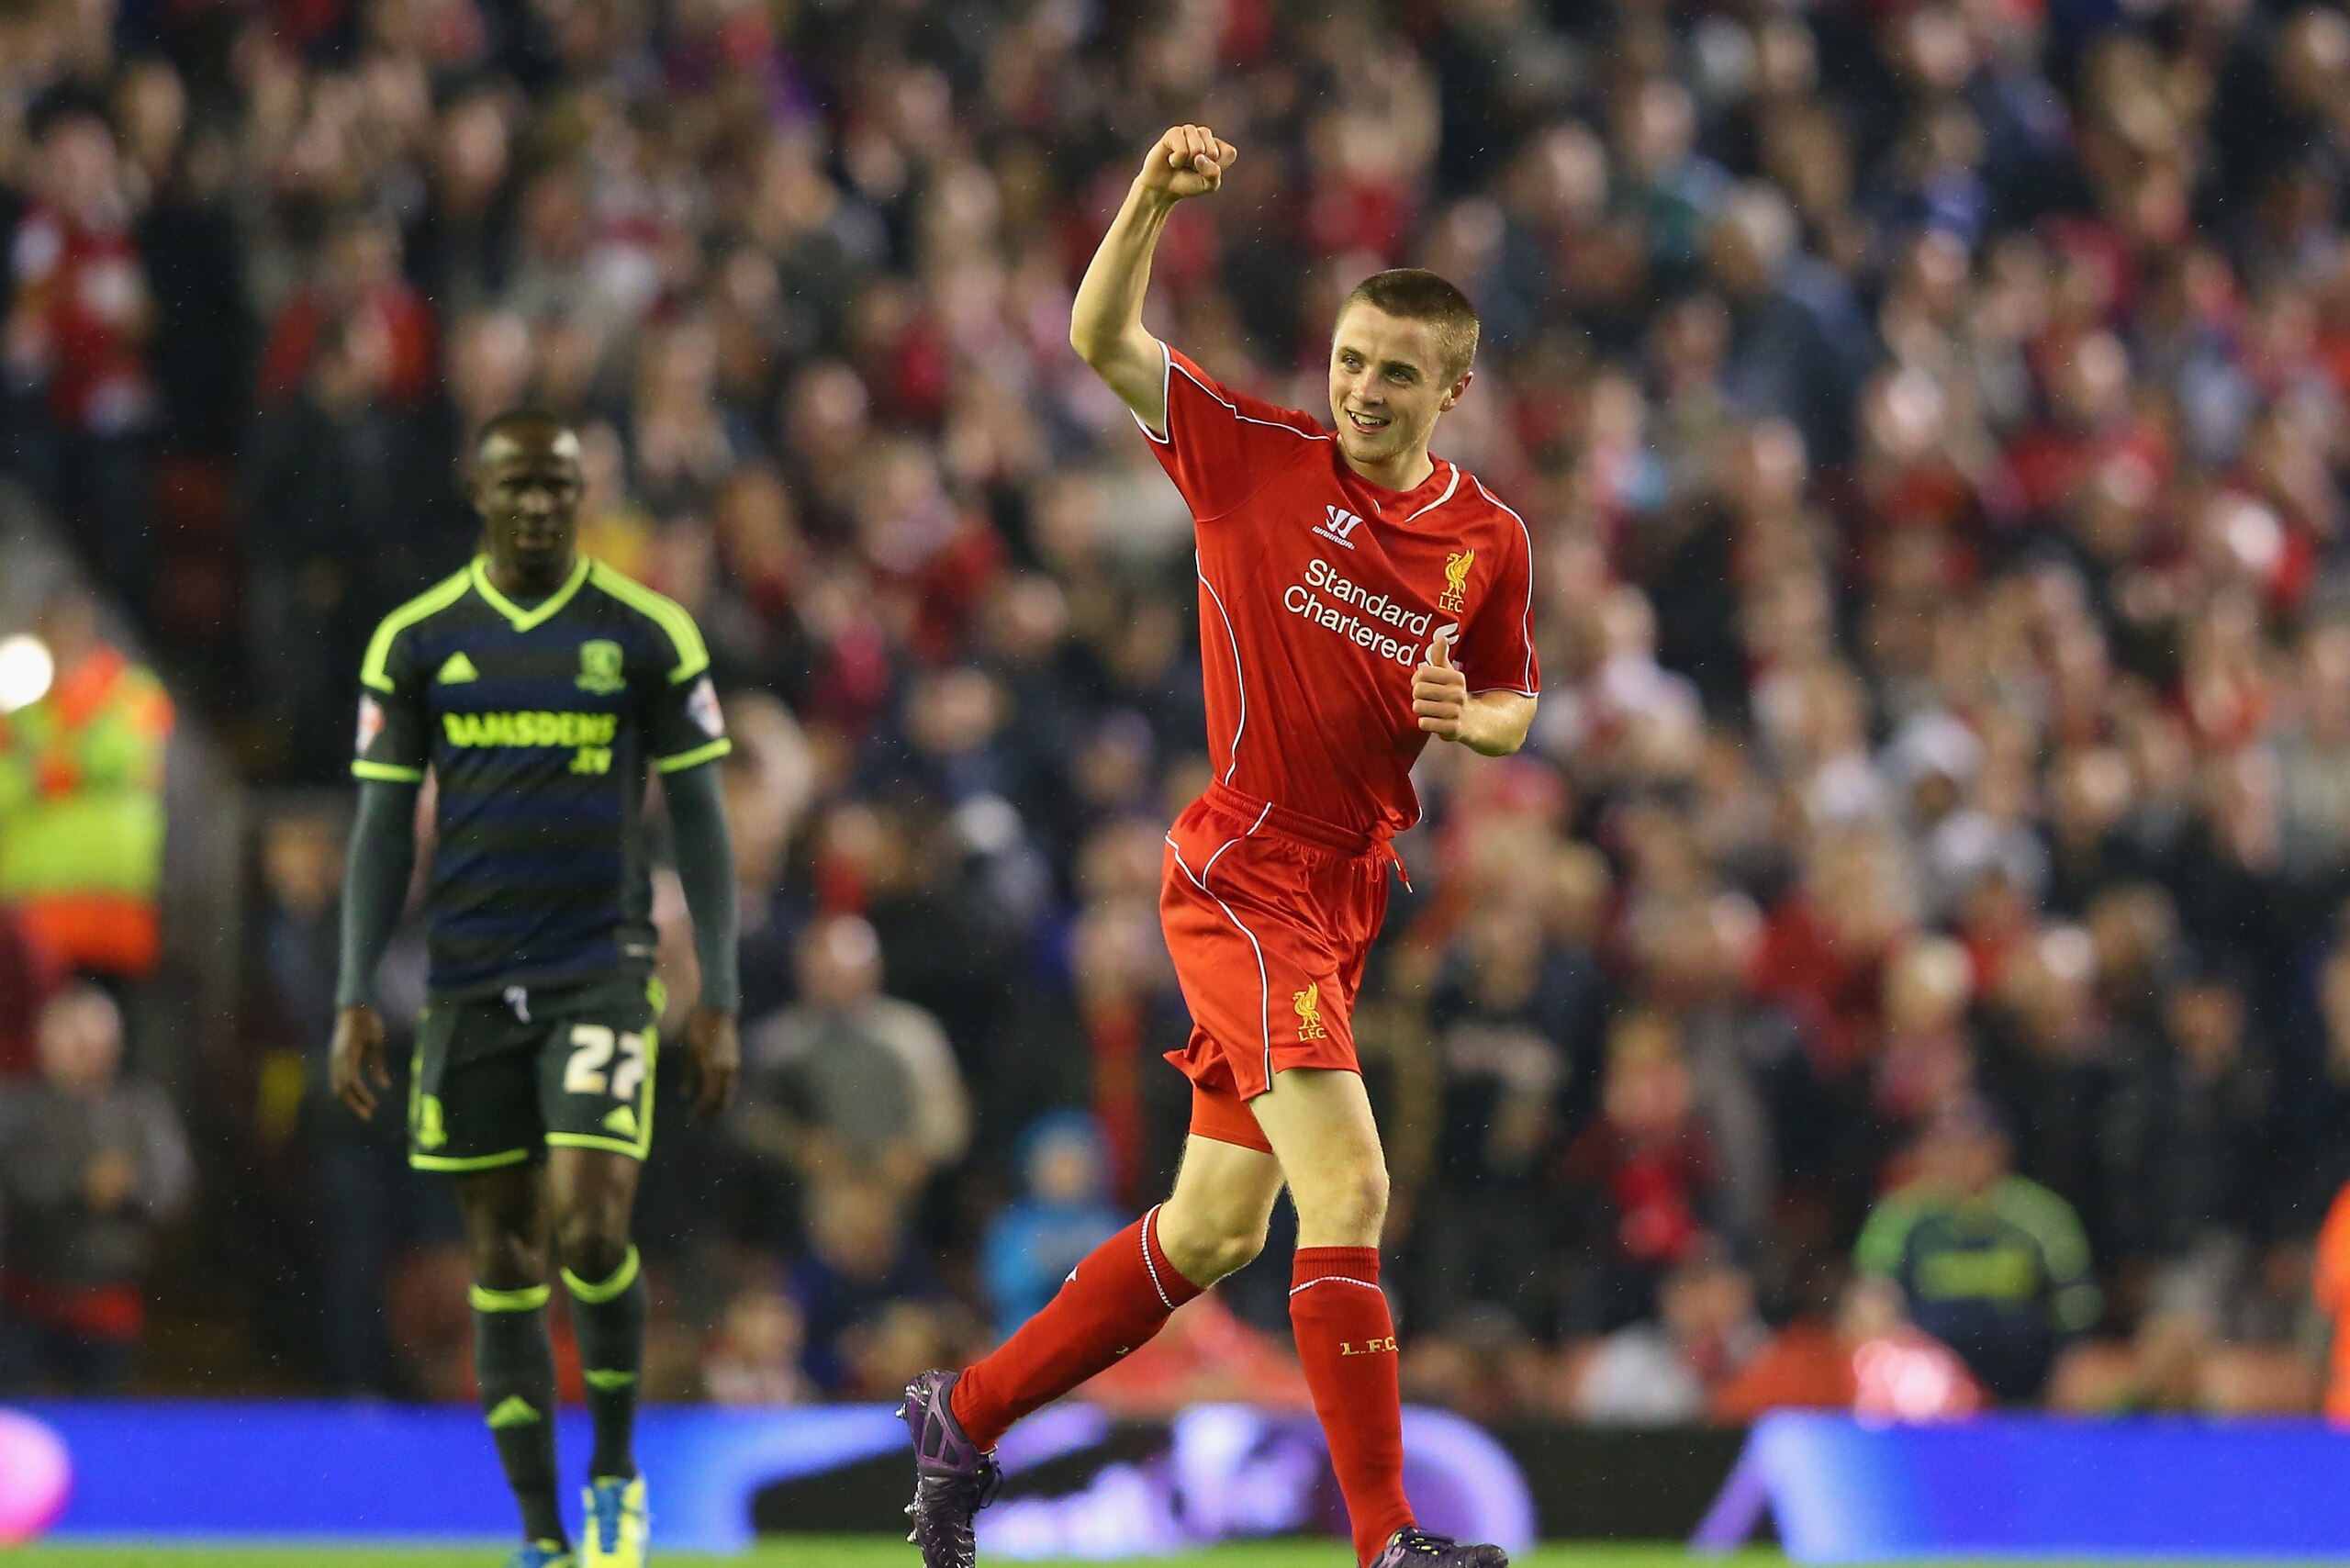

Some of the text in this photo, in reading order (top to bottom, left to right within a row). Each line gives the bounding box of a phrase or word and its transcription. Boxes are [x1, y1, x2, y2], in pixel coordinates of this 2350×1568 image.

[1312, 525, 1353, 550] WARRIOR
[1283, 585, 1419, 667] Chartered
[1304, 558, 1432, 637] Standard
